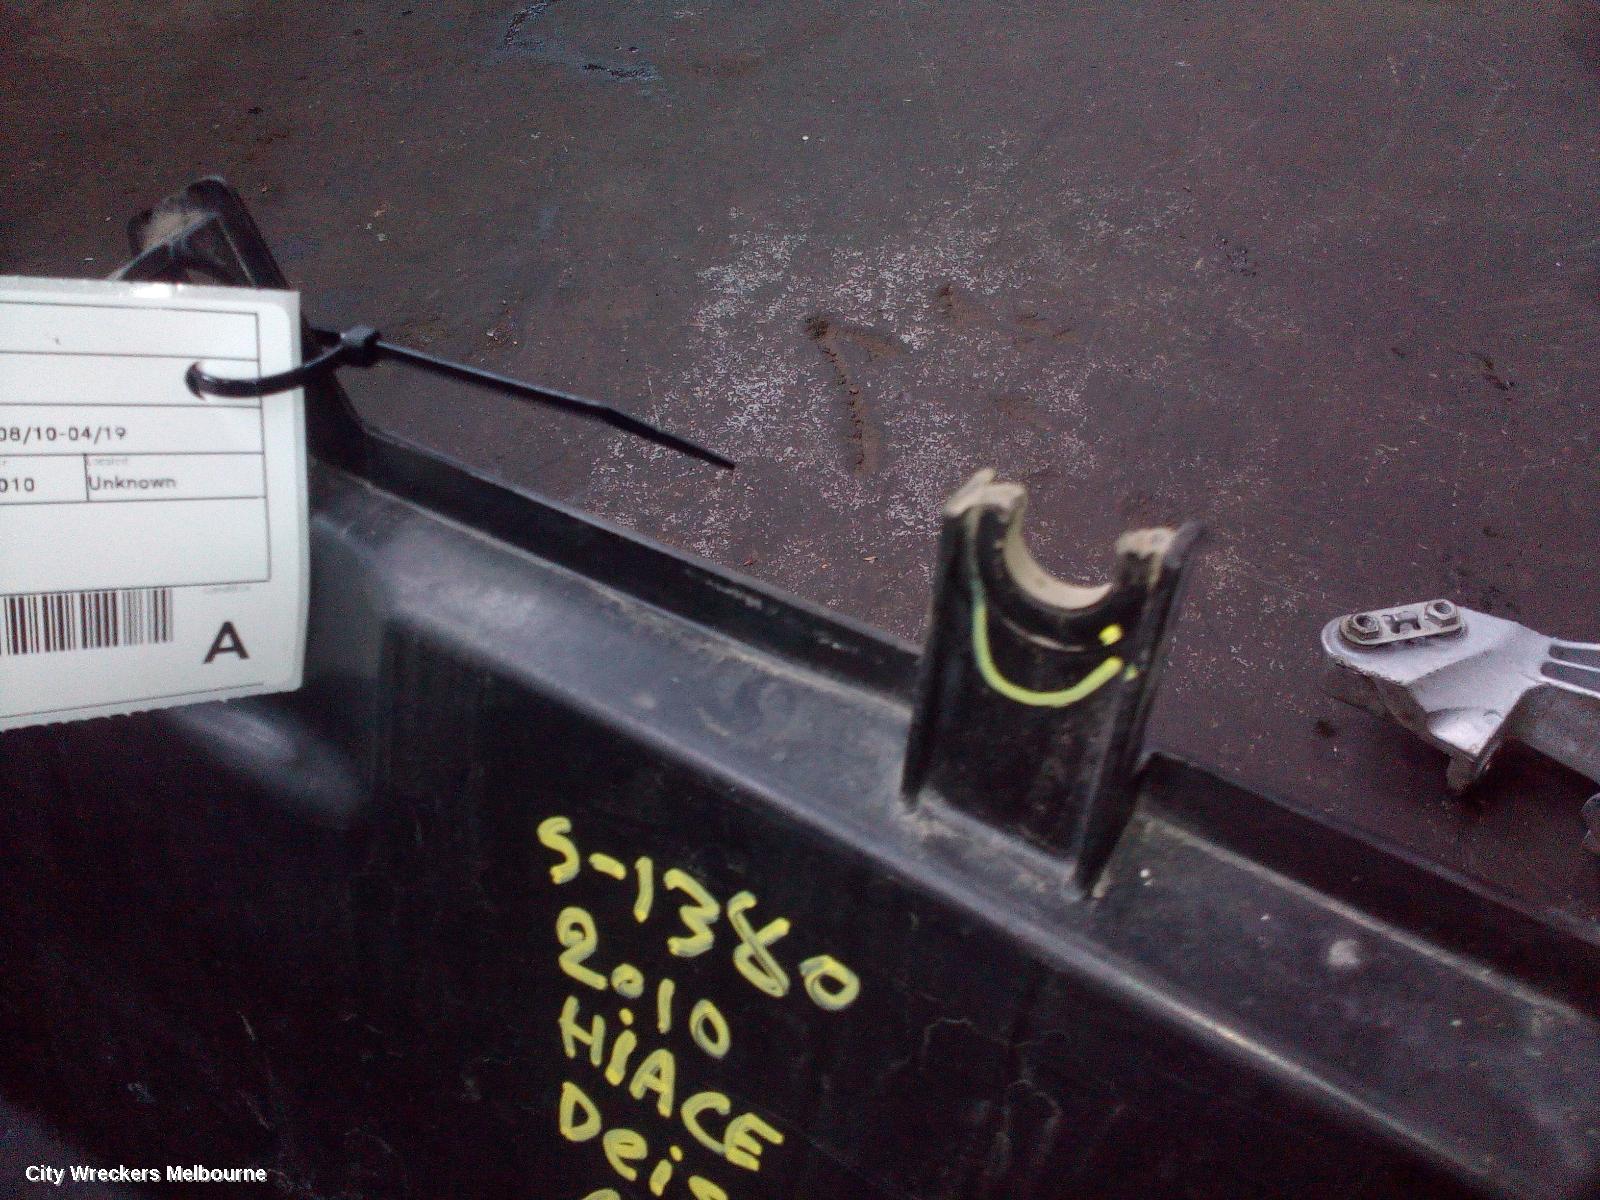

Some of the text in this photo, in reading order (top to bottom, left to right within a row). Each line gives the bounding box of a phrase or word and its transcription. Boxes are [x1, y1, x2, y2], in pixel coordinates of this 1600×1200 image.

[88, 475, 176, 491] Unknown
[203, 620, 249, 664] A
[556, 906, 731, 1059] 2010
